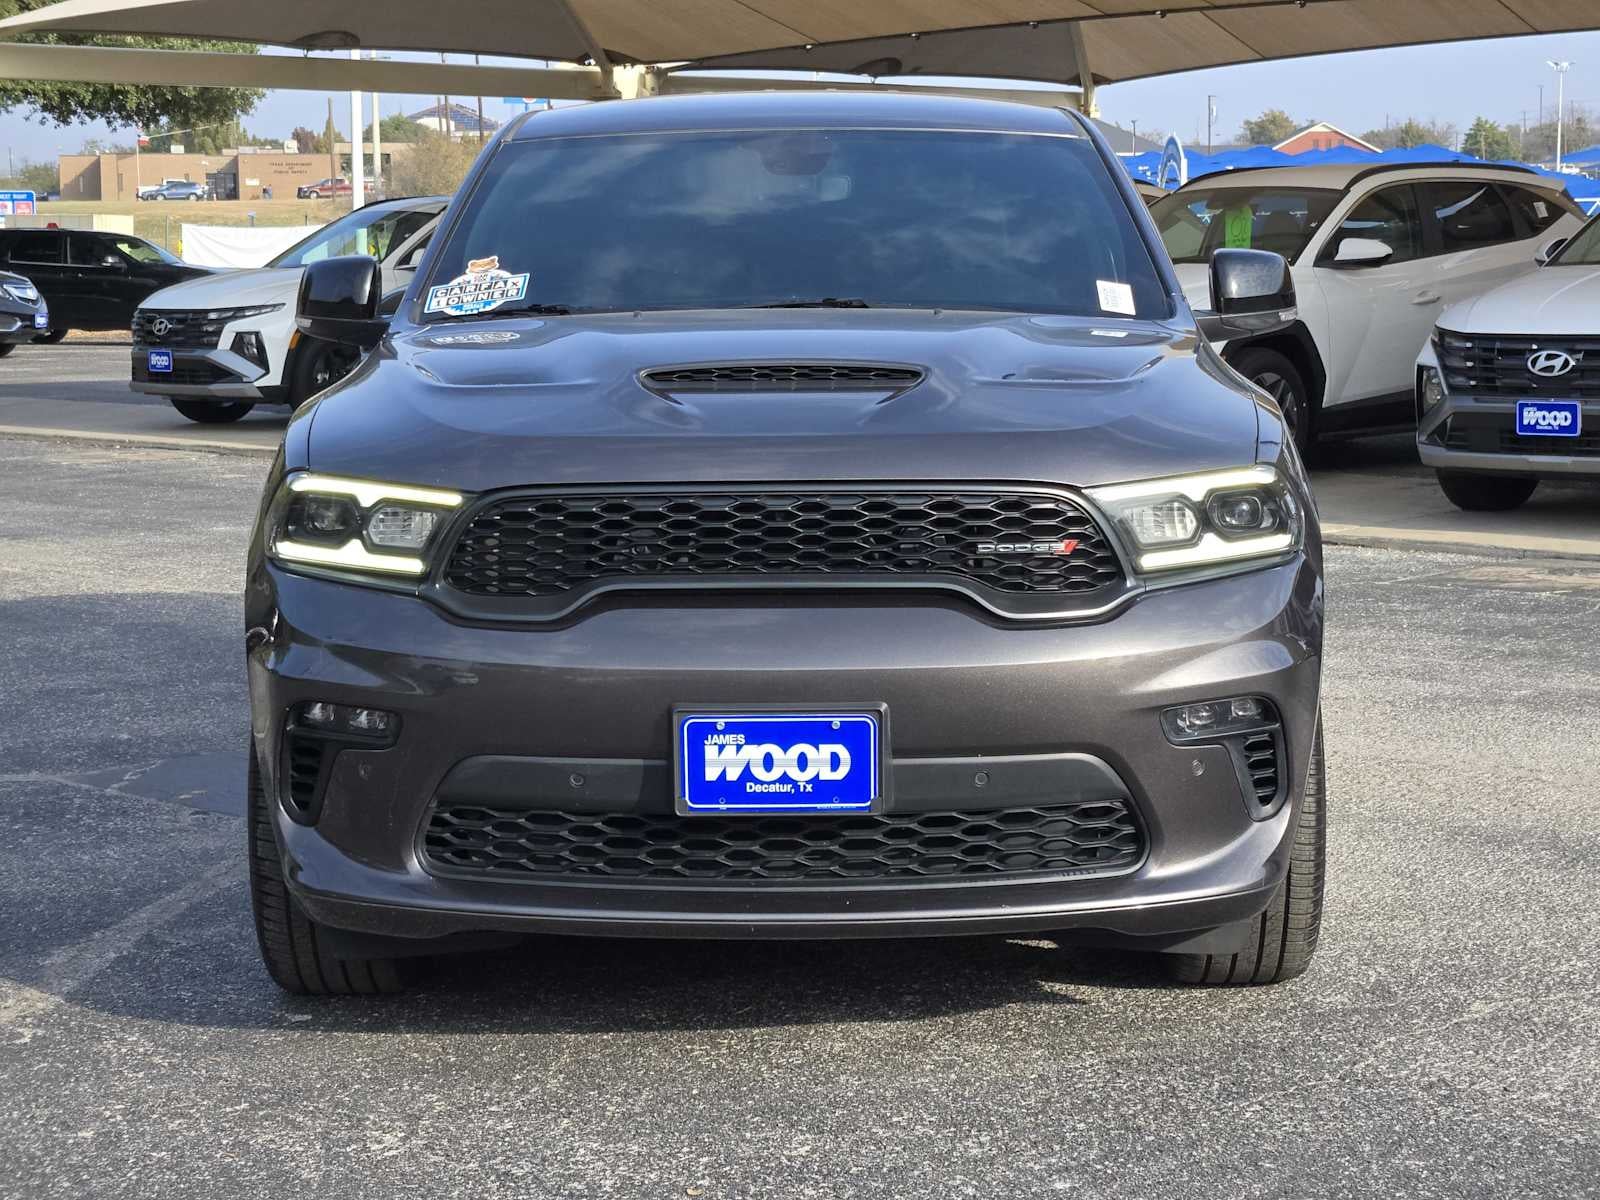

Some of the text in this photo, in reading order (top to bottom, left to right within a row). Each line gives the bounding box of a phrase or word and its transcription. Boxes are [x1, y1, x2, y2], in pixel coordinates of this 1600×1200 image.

[434, 280, 520, 298] CARFAX
[447, 288, 519, 306] OWNER
[1523, 410, 1572, 426] WOOD
[977, 543, 1065, 553] DODGE
[704, 734, 746, 745] JAMES
[704, 743, 852, 782] WOOD
[746, 782, 813, 794] Decatur, Tx
